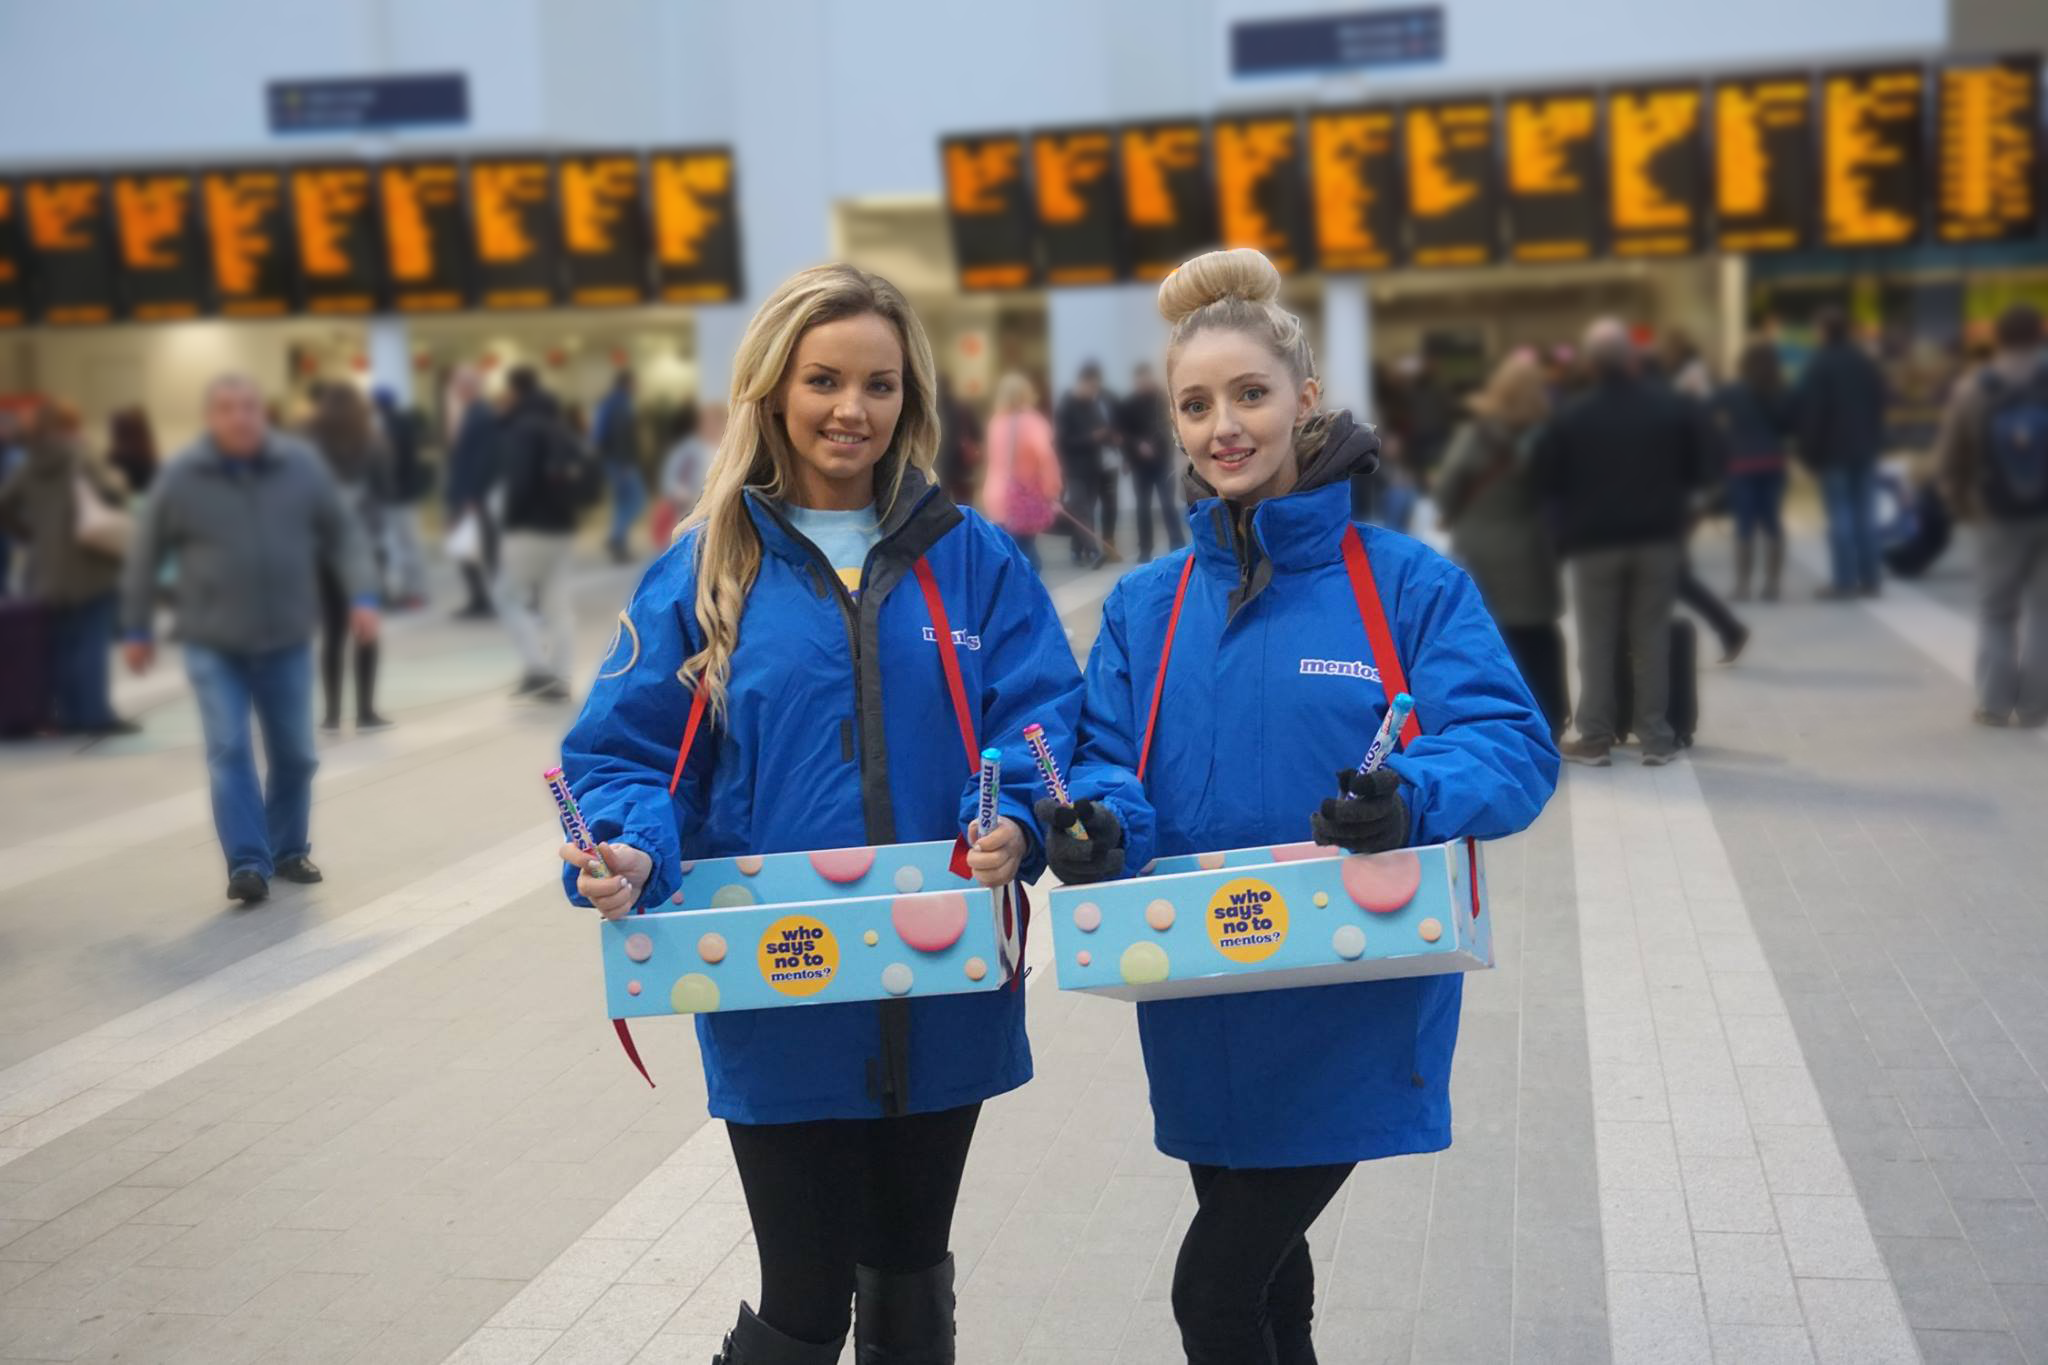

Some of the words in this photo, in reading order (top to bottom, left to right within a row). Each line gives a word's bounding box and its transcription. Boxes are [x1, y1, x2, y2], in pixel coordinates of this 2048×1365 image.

[1027, 738, 1061, 804] mento
[982, 765, 994, 828] mentos
[549, 781, 587, 849] mentos
[1229, 889, 1272, 905] who
[1214, 903, 1264, 920] says
[782, 926, 823, 941] who
[1223, 921, 1248, 934] no
[1252, 917, 1273, 931] to
[766, 940, 815, 956] says
[1220, 932, 1280, 948] mentos?
[774, 957, 800, 969] no
[802, 953, 824, 966] to
[771, 967, 831, 982] mentos?
